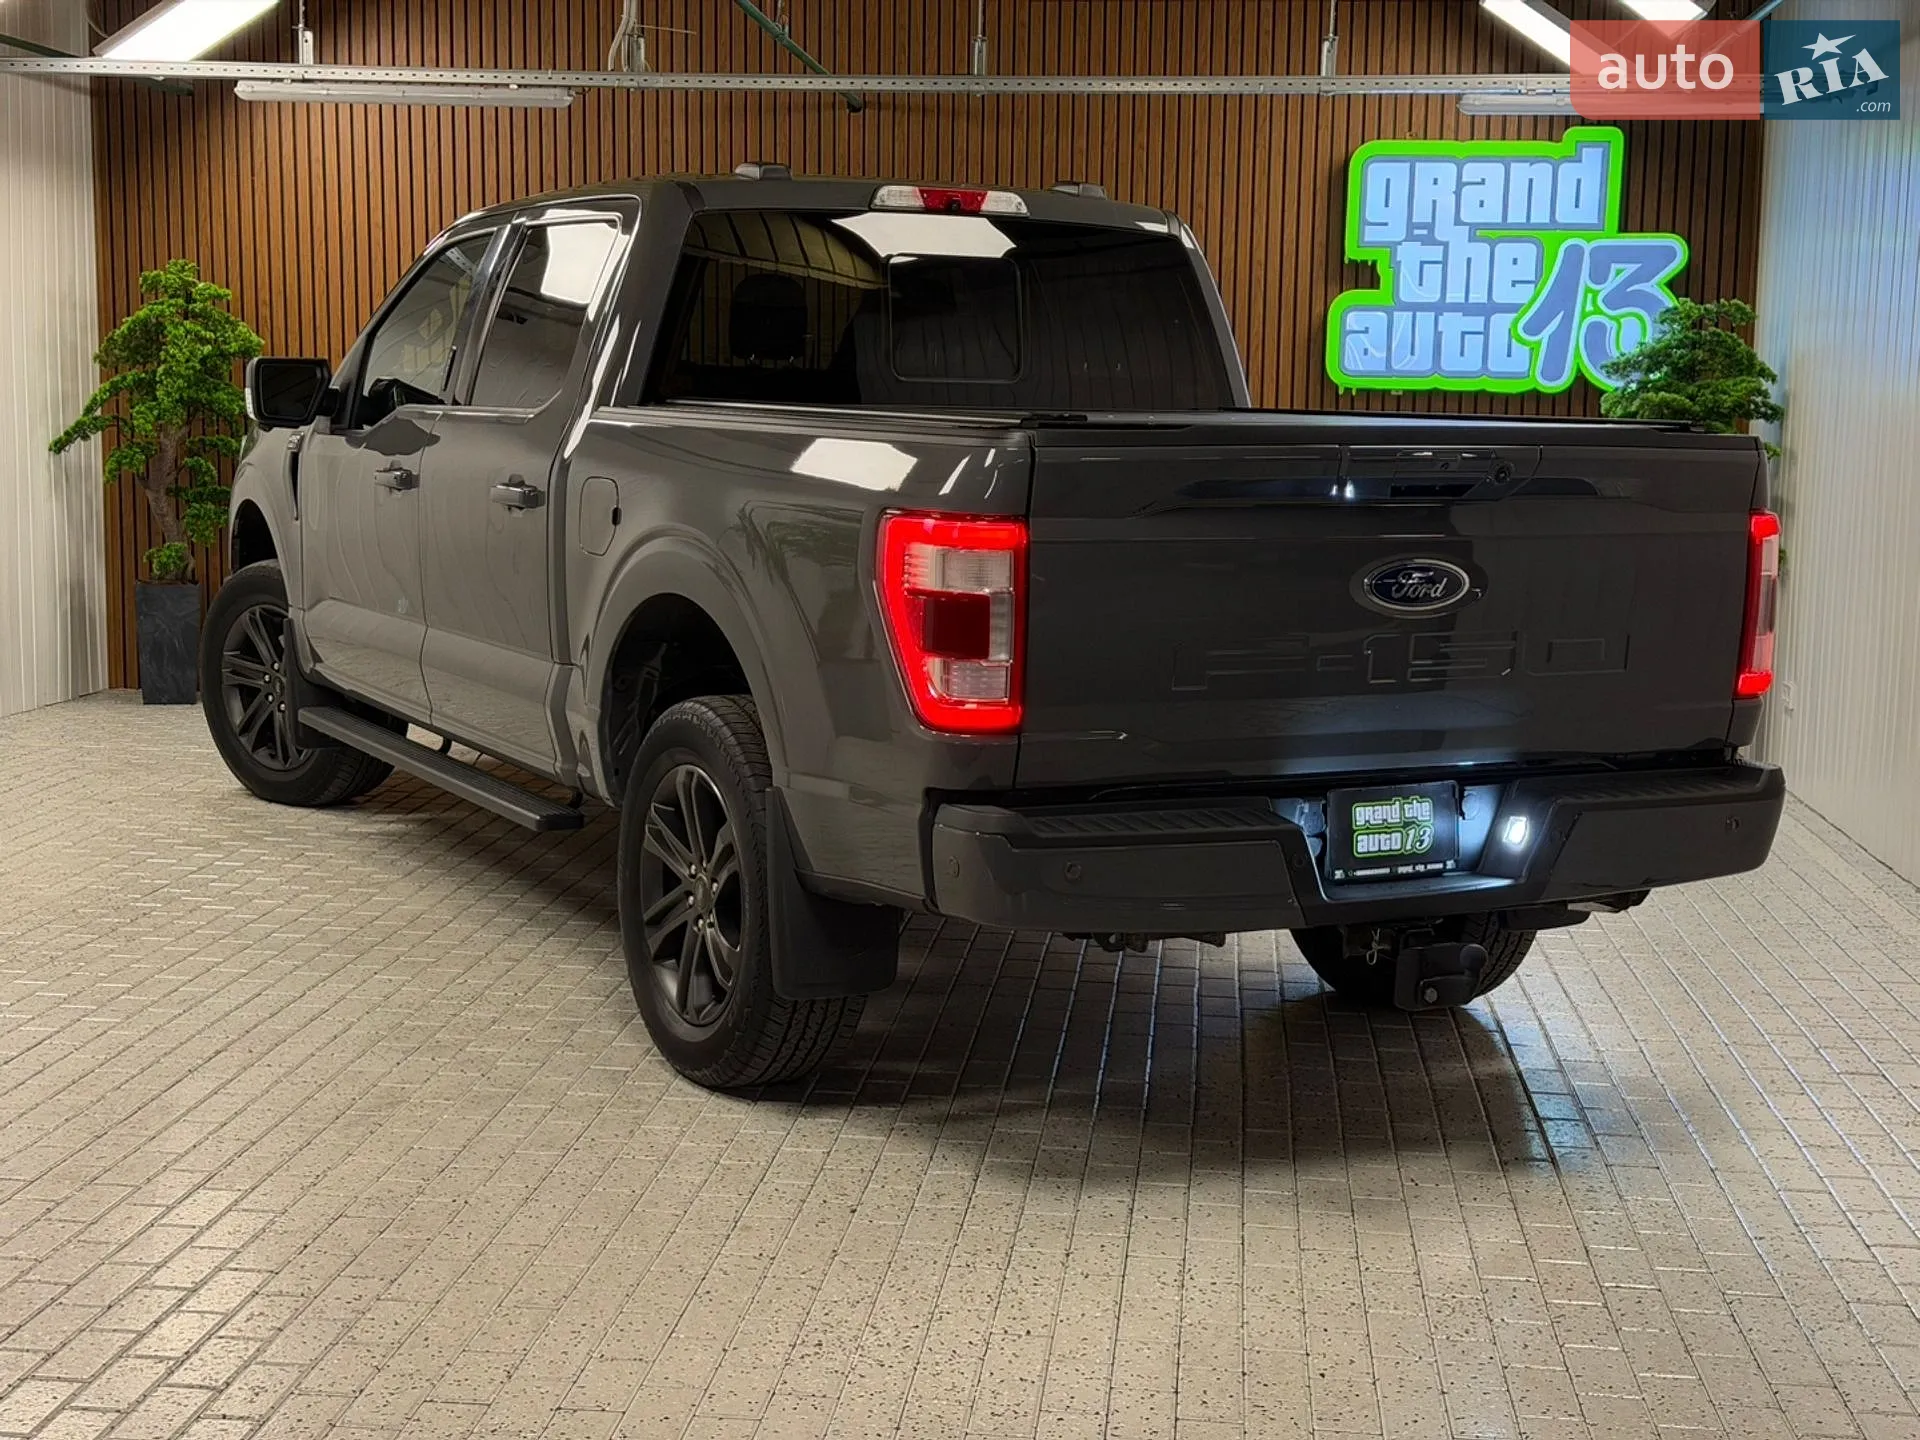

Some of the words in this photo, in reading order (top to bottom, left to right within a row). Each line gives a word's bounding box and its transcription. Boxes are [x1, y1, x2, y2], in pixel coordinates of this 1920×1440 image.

[1397, 226, 1538, 304] the
[1518, 239, 1687, 387] 13
[1391, 569, 1448, 598] Ford
[1172, 631, 1630, 691] F-150
[1356, 832, 1402, 853] auto
[1404, 826, 1433, 851] 13
